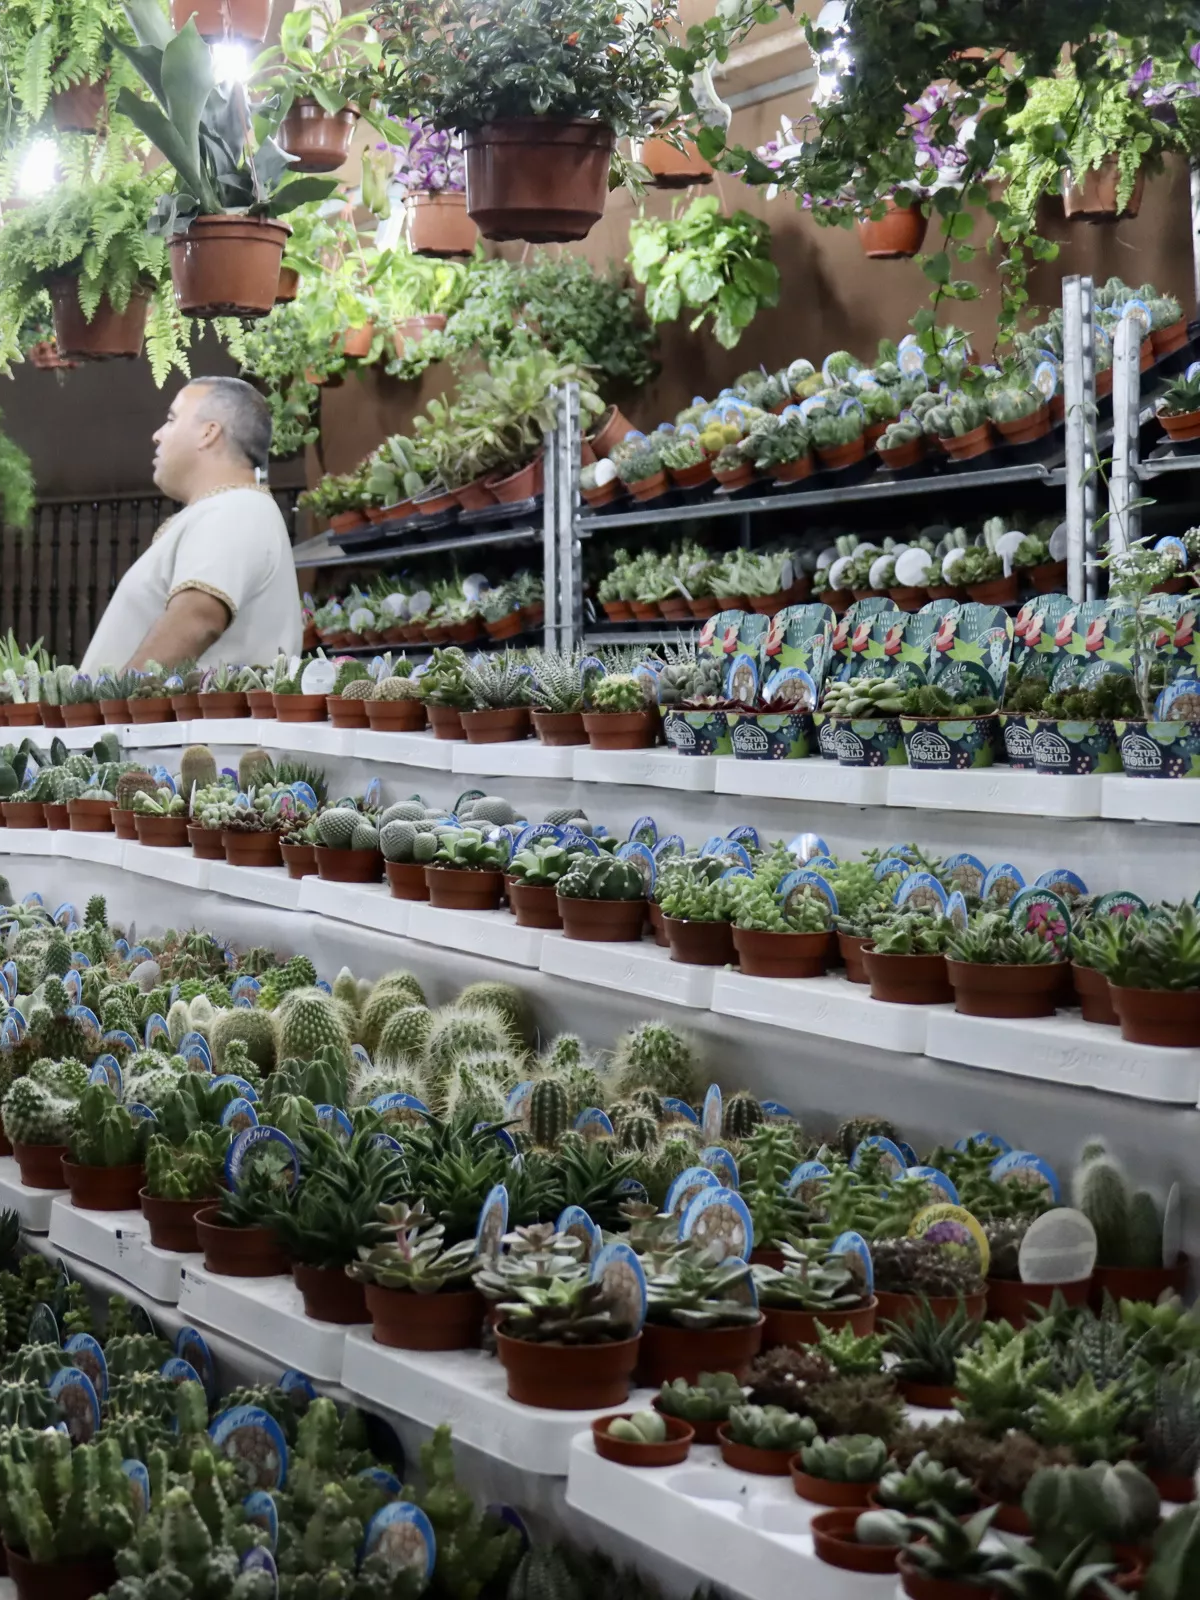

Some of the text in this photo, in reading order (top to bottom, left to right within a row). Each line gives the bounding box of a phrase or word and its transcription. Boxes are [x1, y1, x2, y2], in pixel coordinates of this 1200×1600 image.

[937, 664, 968, 689] assula
[735, 735, 765, 743] CACTUS
[735, 741, 769, 751] WORLD
[912, 743, 947, 752] CACTUS
[1034, 745, 1066, 755] CACTUS
[911, 750, 952, 761] WORLD
[1123, 748, 1157, 757] CACTUS
[1035, 752, 1071, 764] WORLD
[1124, 755, 1162, 767] WORLD
[316, 1109, 334, 1119] lant
